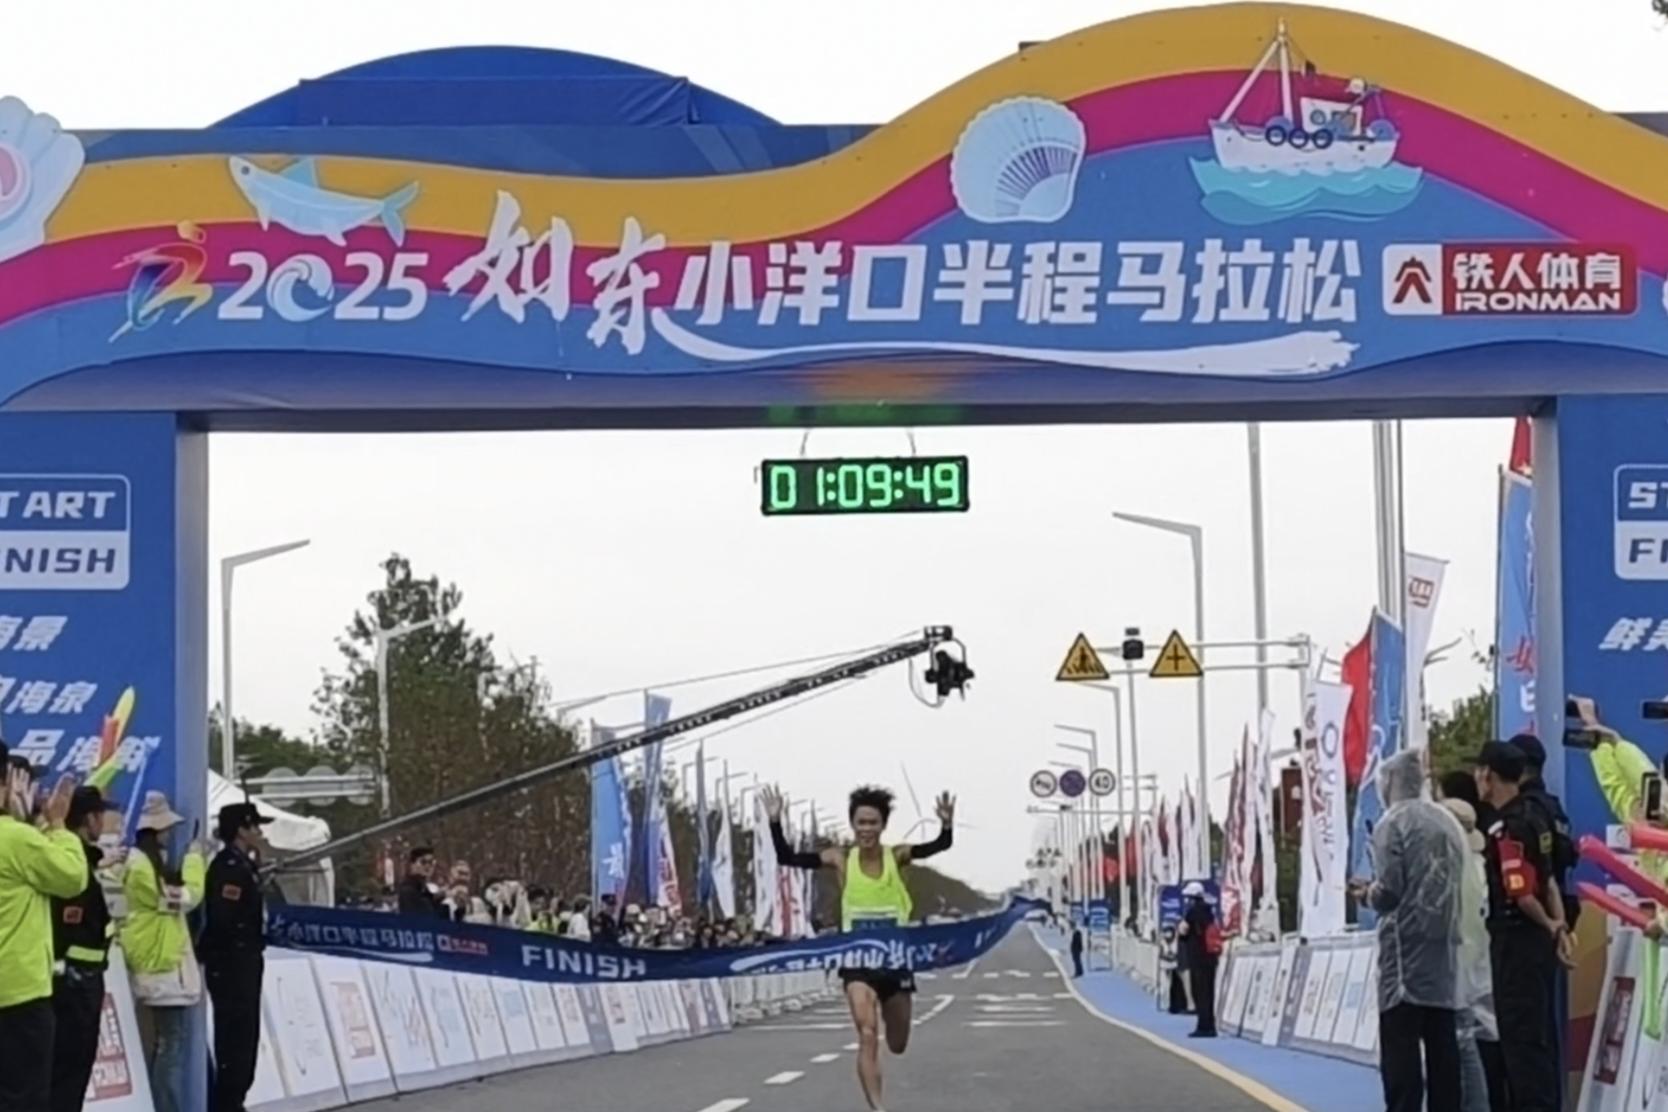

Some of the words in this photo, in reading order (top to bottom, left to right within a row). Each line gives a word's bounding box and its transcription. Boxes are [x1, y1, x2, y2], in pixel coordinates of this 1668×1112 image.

[1453, 253, 1621, 290] 铁人体育
[1455, 292, 1621, 311] IRONMAN
[1628, 481, 1668, 509] S
[521, 943, 648, 978] FINISH
